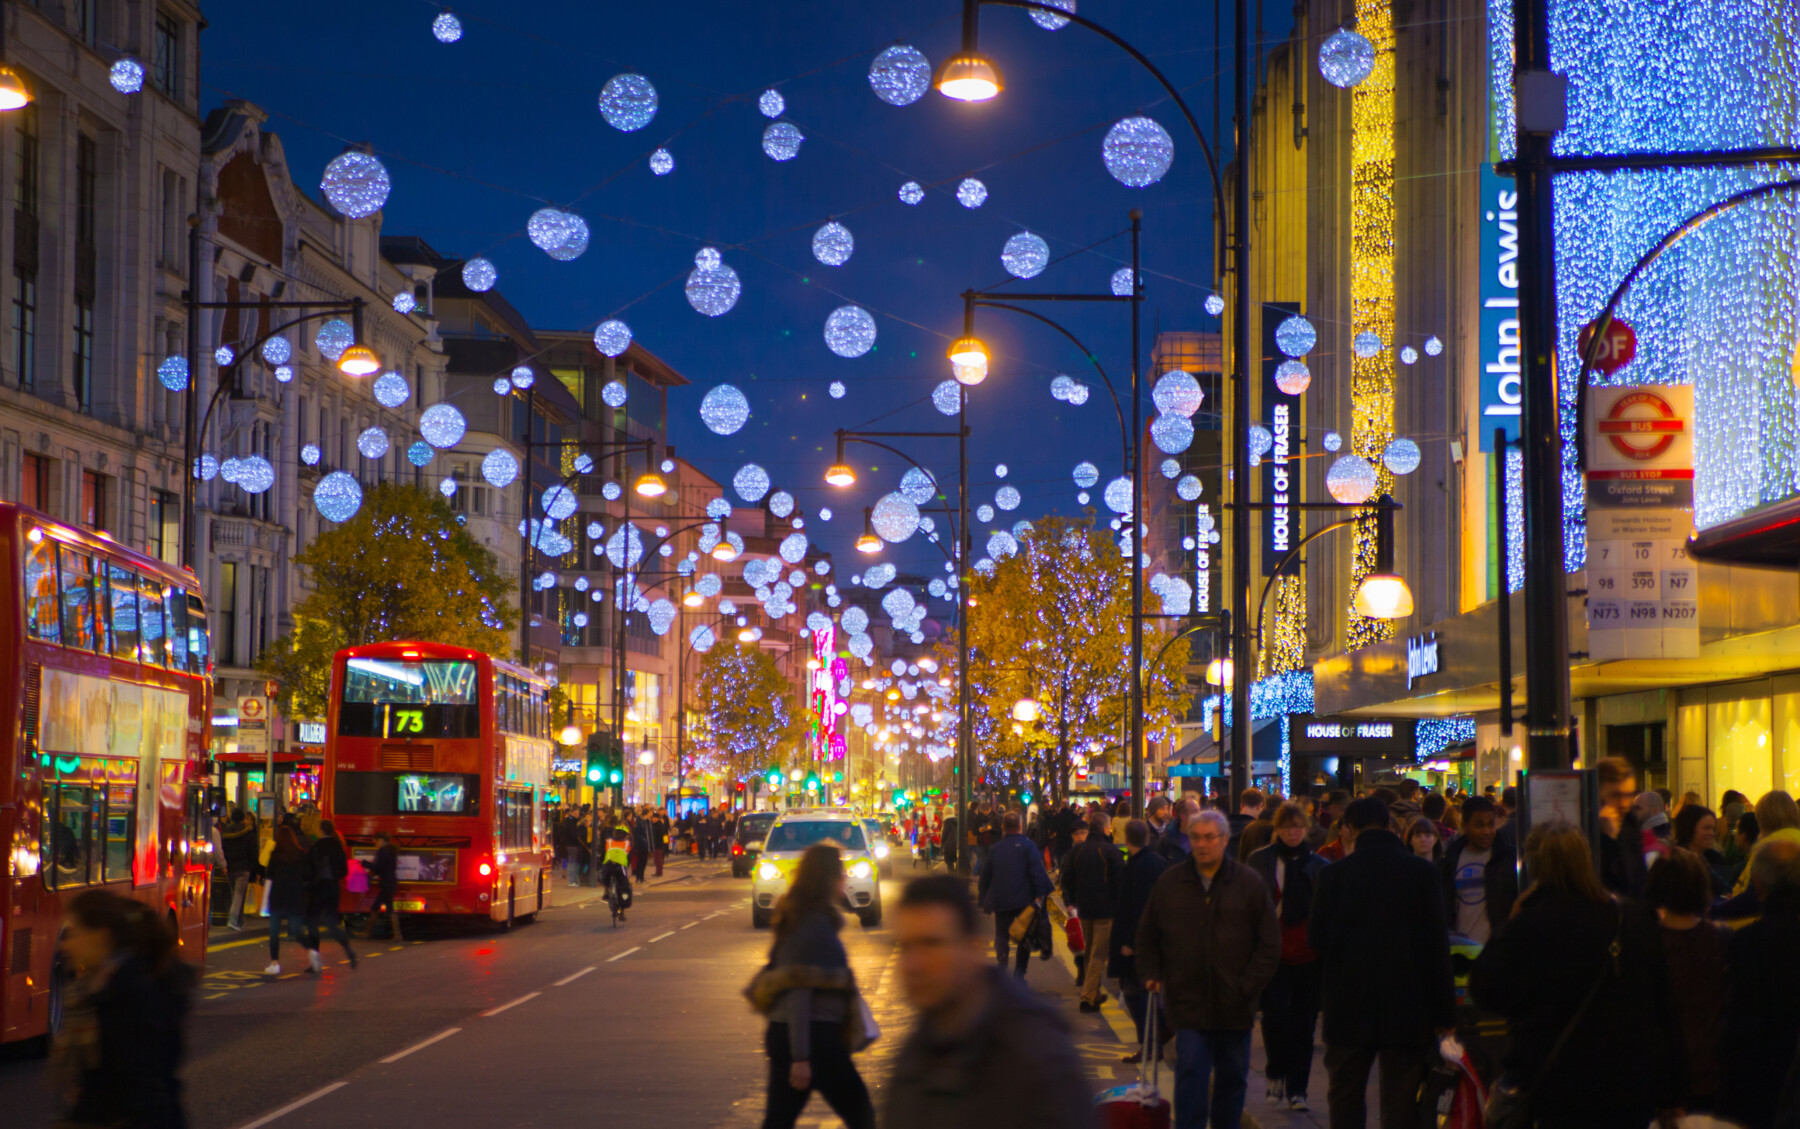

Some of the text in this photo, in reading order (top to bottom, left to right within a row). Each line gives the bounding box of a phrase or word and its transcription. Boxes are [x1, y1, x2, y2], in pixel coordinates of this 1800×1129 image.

[1630, 422, 1653, 432] BUS
[1273, 404, 1289, 551] HOUSE OF FRASER
[1620, 471, 1637, 479] BUS
[1607, 484, 1675, 494] Oxford Street
[1197, 503, 1209, 613] HOUSE OF FRAER
[1602, 549, 1609, 559] 7
[1635, 548, 1650, 559] 10
[1672, 548, 1687, 559] 73
[1598, 578, 1615, 589] 98
[1631, 578, 1655, 589] 390
[1670, 578, 1688, 589] N7
[1593, 608, 1620, 619] N73
[1630, 608, 1657, 619] N98
[1662, 607, 1697, 619] N207
[396, 711, 424, 732] 73
[1306, 723, 1393, 738] HOUSE OF FRASER
